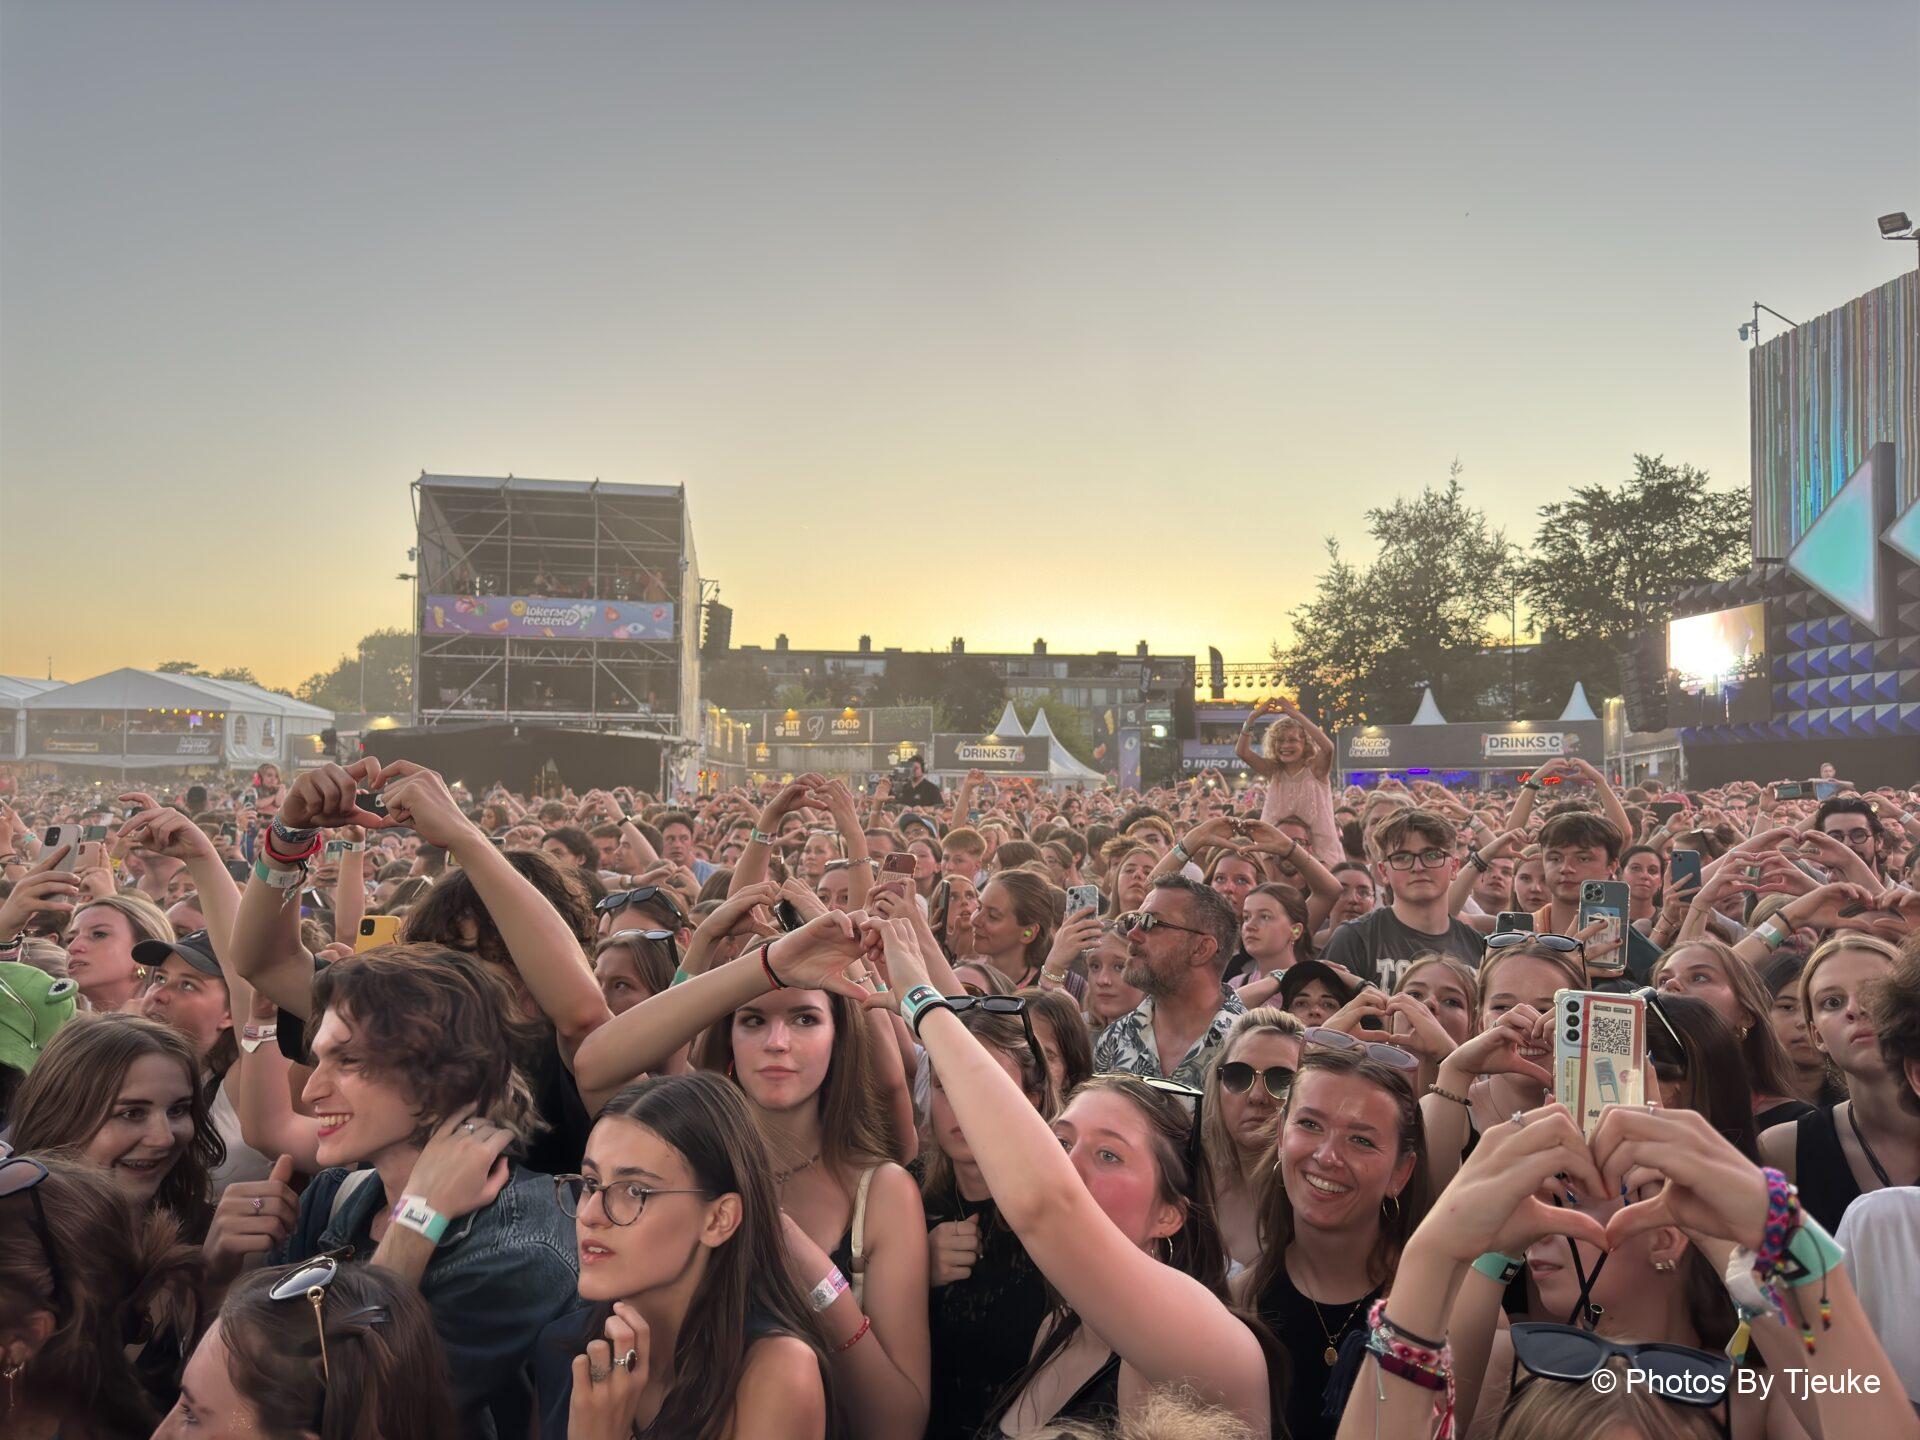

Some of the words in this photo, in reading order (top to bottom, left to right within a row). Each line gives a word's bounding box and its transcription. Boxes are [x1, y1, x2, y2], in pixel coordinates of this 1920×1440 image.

[832, 719, 860, 729] FOOD
[1489, 736, 1546, 748] DRINKS
[1549, 735, 1560, 747] C
[962, 748, 1007, 758] DRINKS
[1008, 749, 1016, 758] 7
[1194, 759, 1228, 768] INFO
